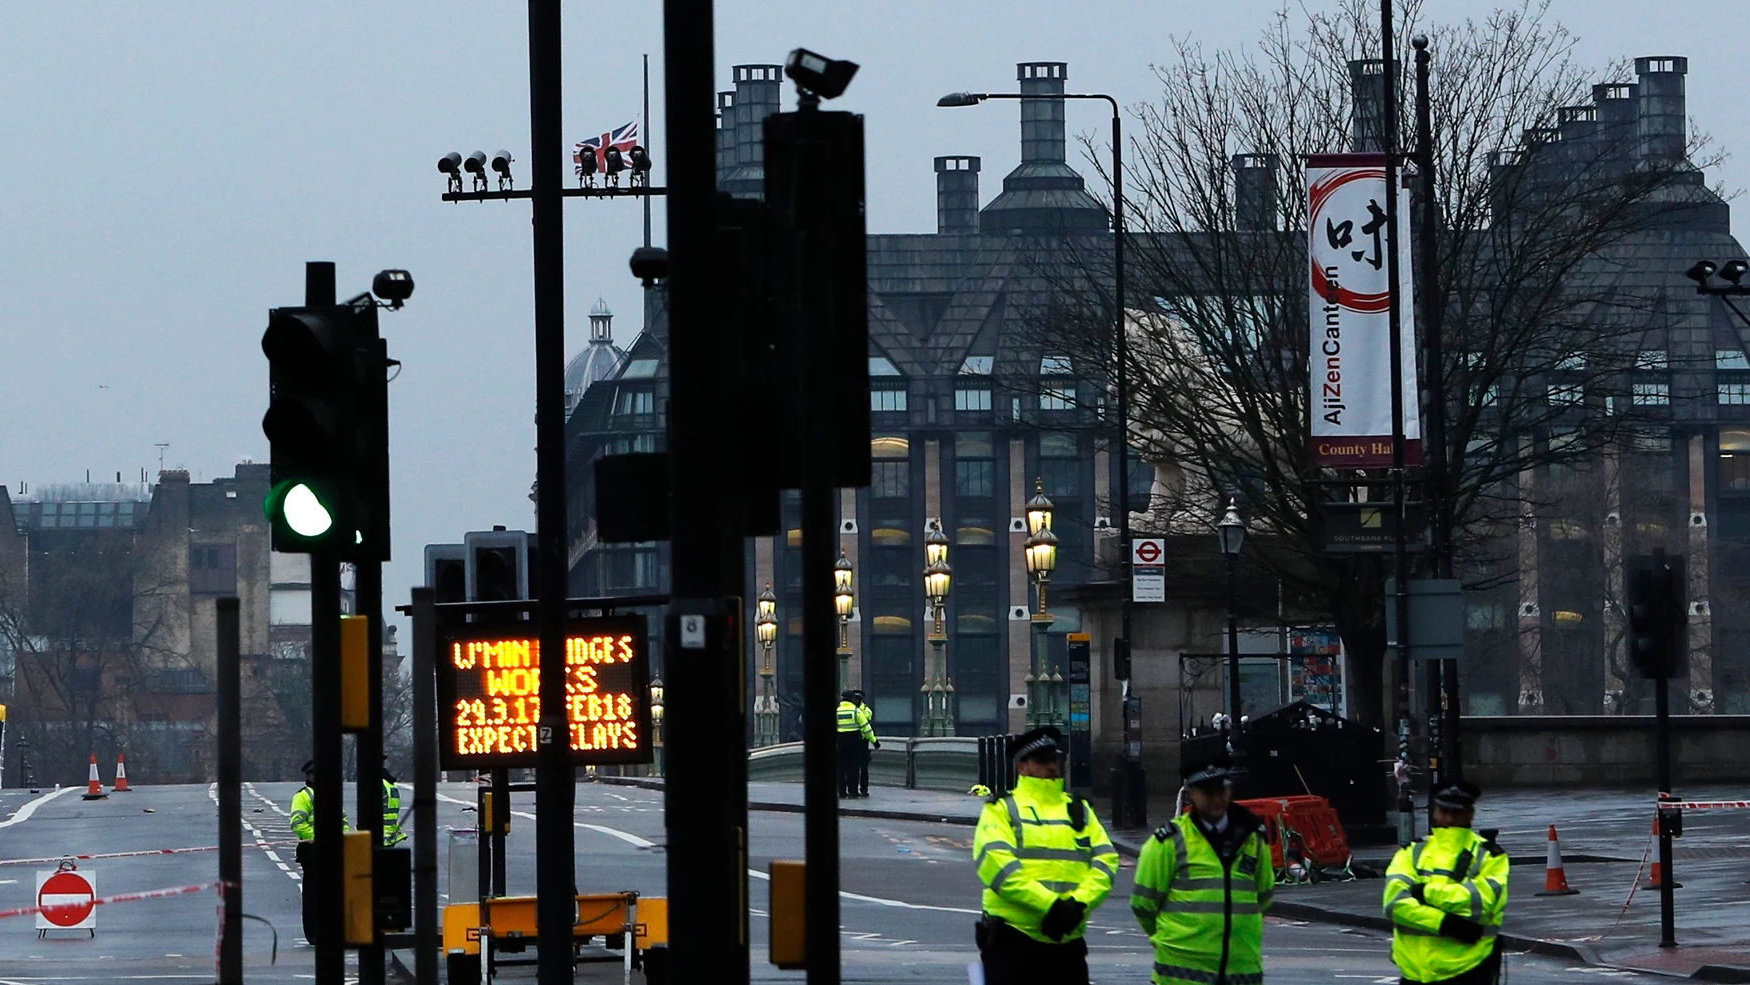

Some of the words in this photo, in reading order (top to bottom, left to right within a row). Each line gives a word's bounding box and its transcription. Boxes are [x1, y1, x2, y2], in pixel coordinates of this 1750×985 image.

[1323, 266, 1345, 426] AjiZenCanteen
[1318, 443, 1367, 457] County
[1371, 443, 1394, 455] Hal
[454, 639, 530, 669] W'MIN
[536, 635, 633, 667] IDGES
[486, 666, 597, 696] WOS
[458, 725, 538, 754] EXPECT
[568, 722, 637, 751] ELAYS
